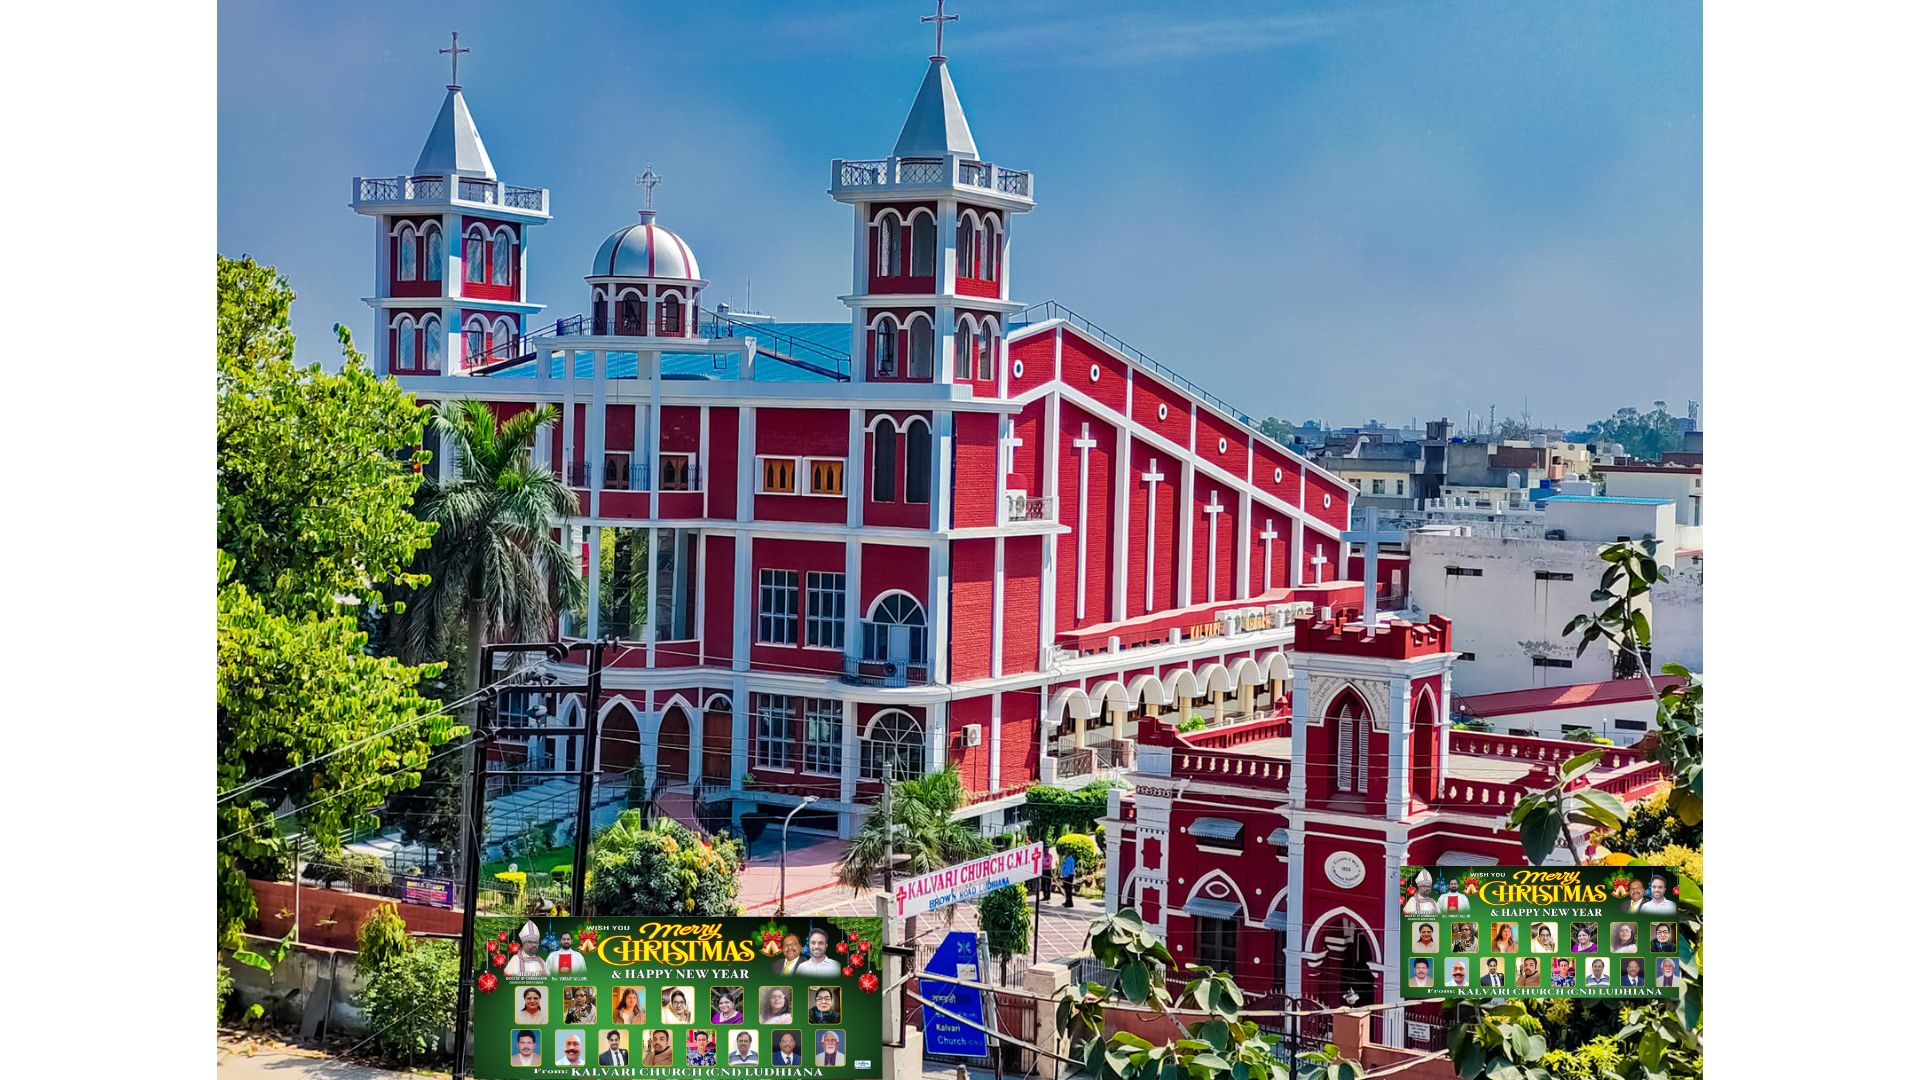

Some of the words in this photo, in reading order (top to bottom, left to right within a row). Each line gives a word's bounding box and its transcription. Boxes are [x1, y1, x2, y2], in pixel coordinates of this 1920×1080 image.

[908, 869, 958, 900] KALVARI
[960, 856, 1005, 884] CHURCH
[929, 892, 956, 908] BROWN
[959, 886, 976, 898] ROAD
[936, 1024, 960, 1032] Kalvari
[938, 1035, 966, 1045] Church
